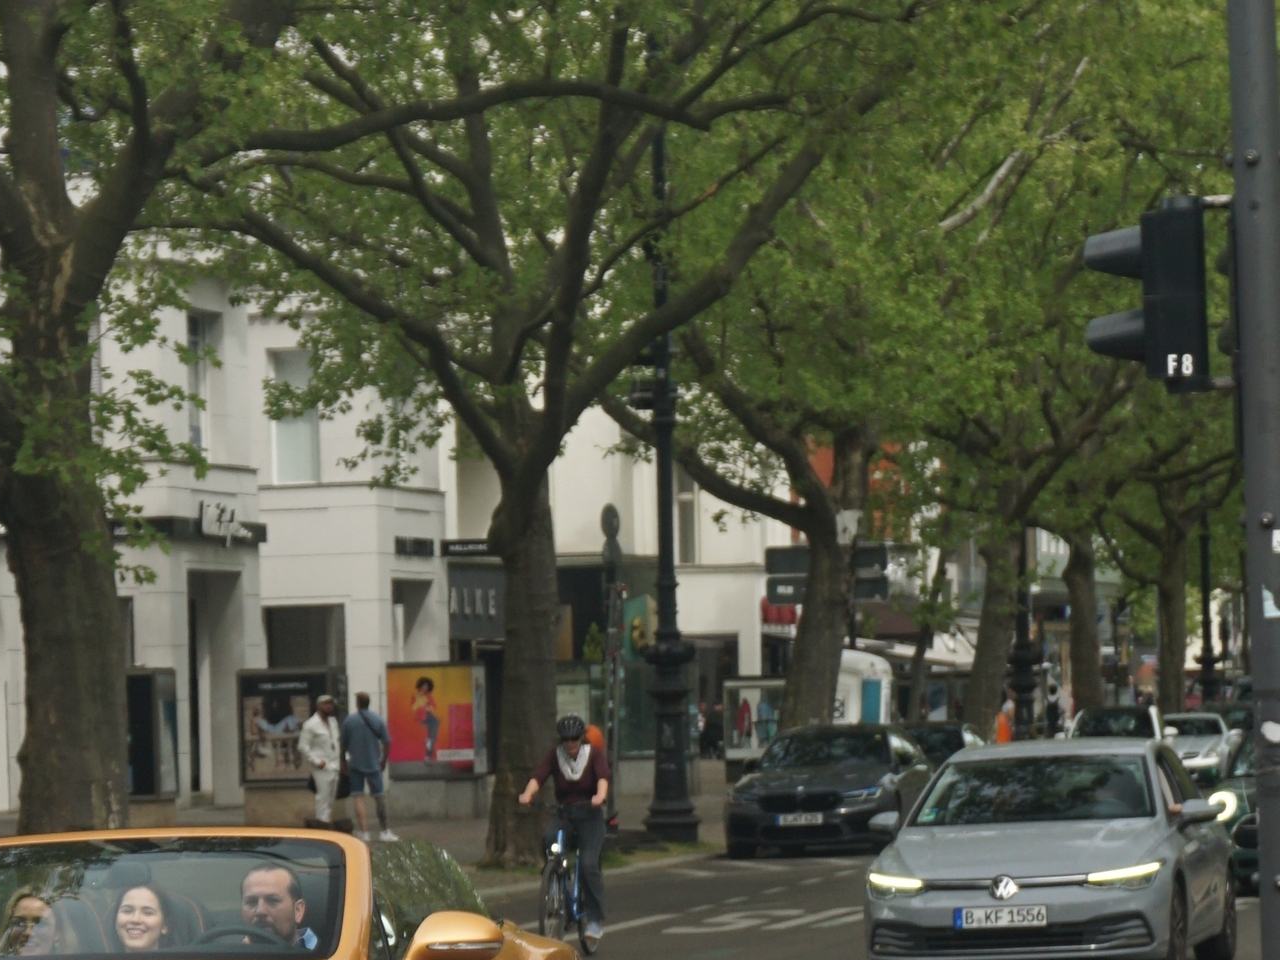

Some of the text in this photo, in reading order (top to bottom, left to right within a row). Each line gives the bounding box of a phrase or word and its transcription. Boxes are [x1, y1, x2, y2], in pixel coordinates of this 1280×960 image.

[965, 910, 975, 925] B
[984, 908, 1003, 924] KF
[1007, 906, 1045, 923] 1556
